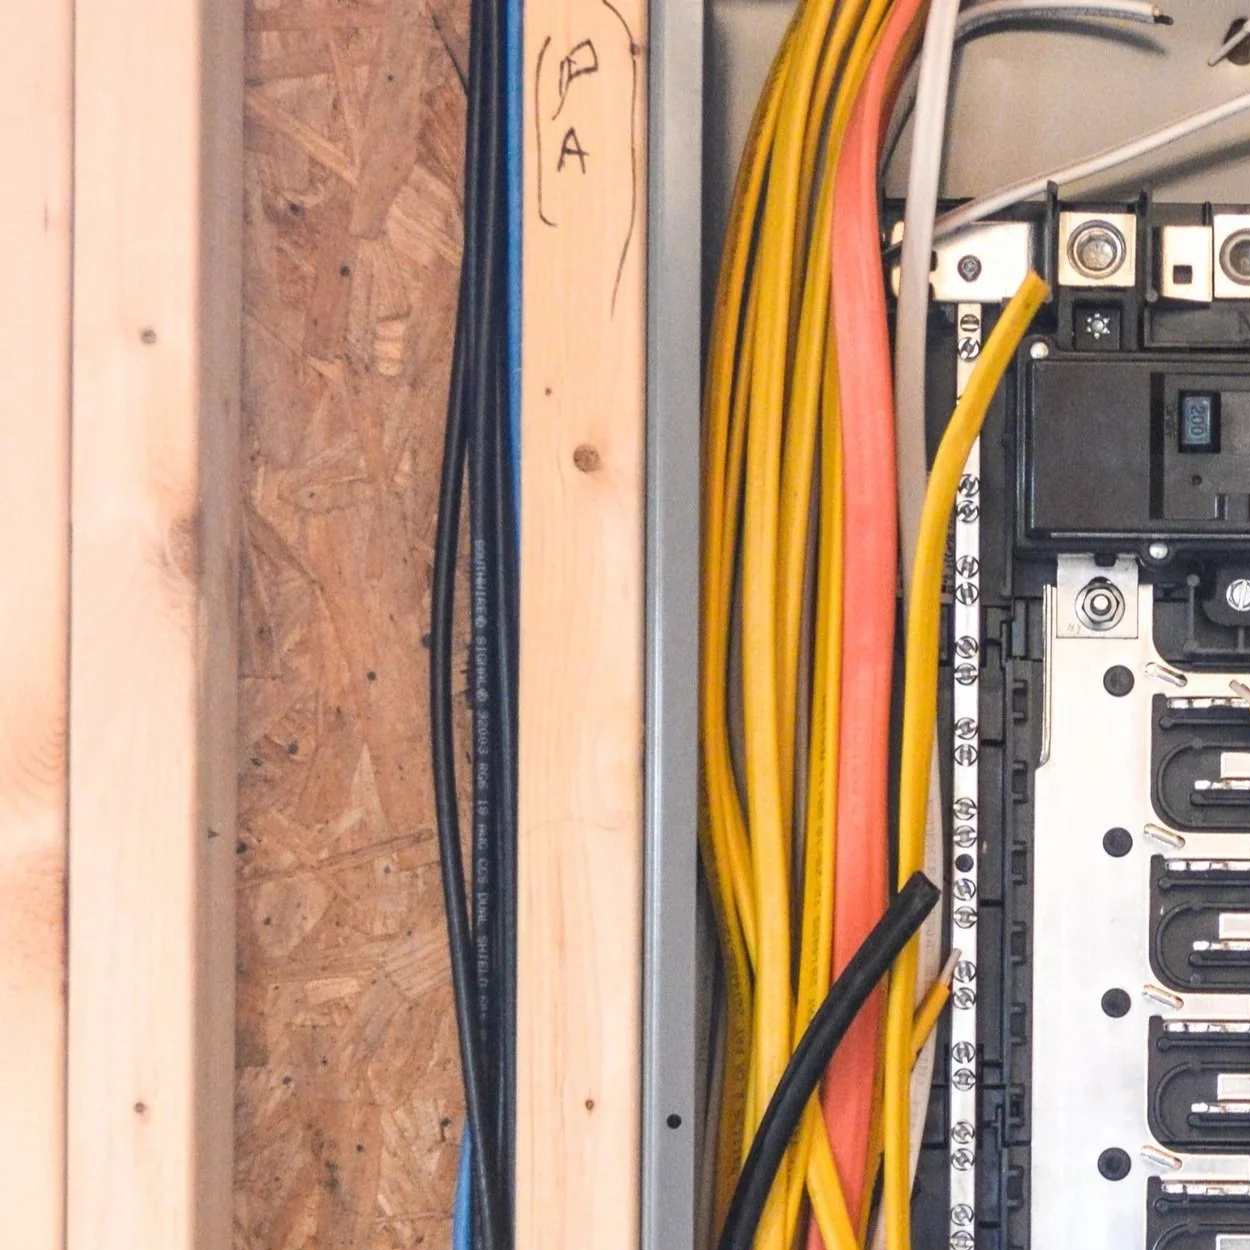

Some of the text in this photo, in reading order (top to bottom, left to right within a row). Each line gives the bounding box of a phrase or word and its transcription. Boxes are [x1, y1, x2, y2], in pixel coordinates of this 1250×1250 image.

[557, 127, 589, 174] A
[1190, 406, 1205, 437] 200
[477, 762, 489, 789] RG6
[477, 823, 489, 850] AWG
[477, 892, 489, 923] DUAL
[477, 935, 489, 988] SHIELD
